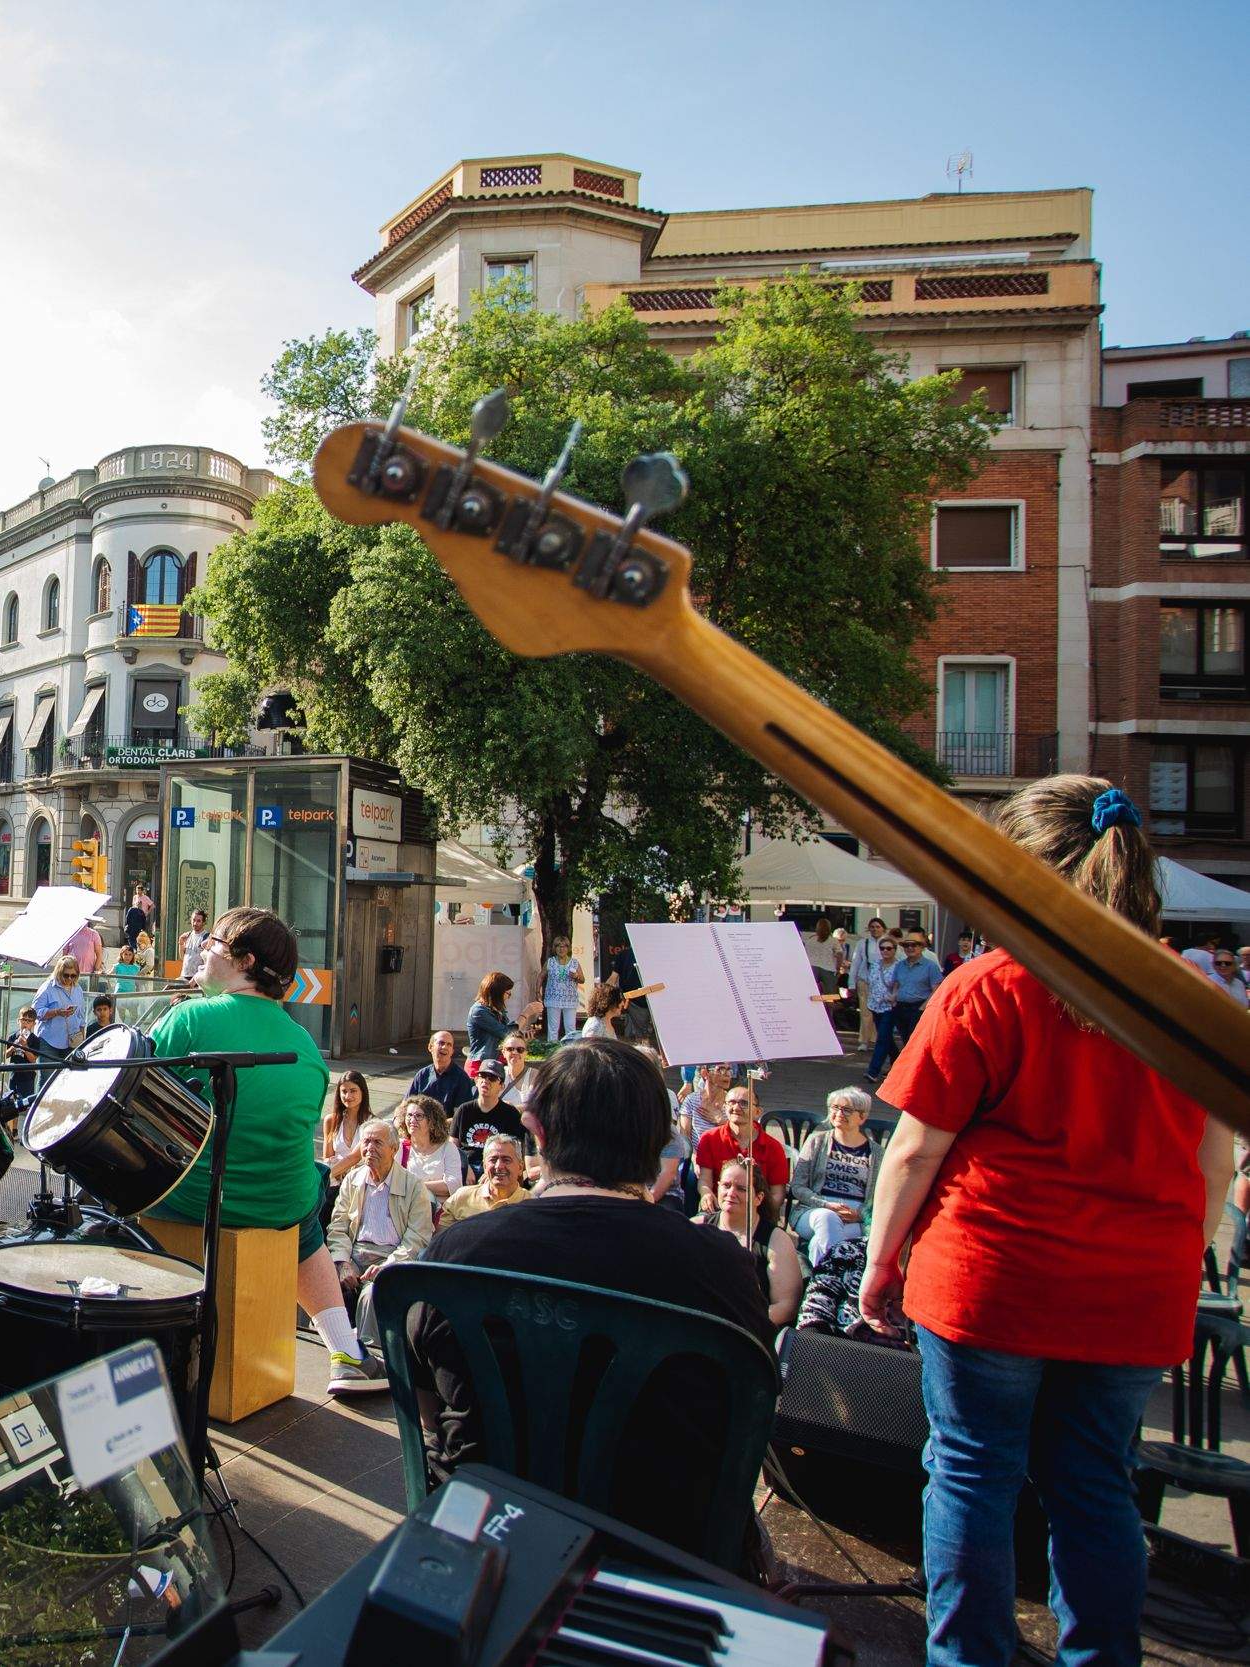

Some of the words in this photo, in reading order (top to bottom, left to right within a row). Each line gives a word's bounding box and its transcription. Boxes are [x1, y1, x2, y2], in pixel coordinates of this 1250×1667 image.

[140, 451, 194, 471] 1924
[118, 748, 156, 757] DENTAL
[158, 748, 196, 759] CLARIS
[201, 809, 243, 822] telpark
[262, 809, 272, 826] P
[288, 809, 335, 822] telpark
[360, 801, 395, 825] telpark
[482, 1503, 525, 1541] FP-4
